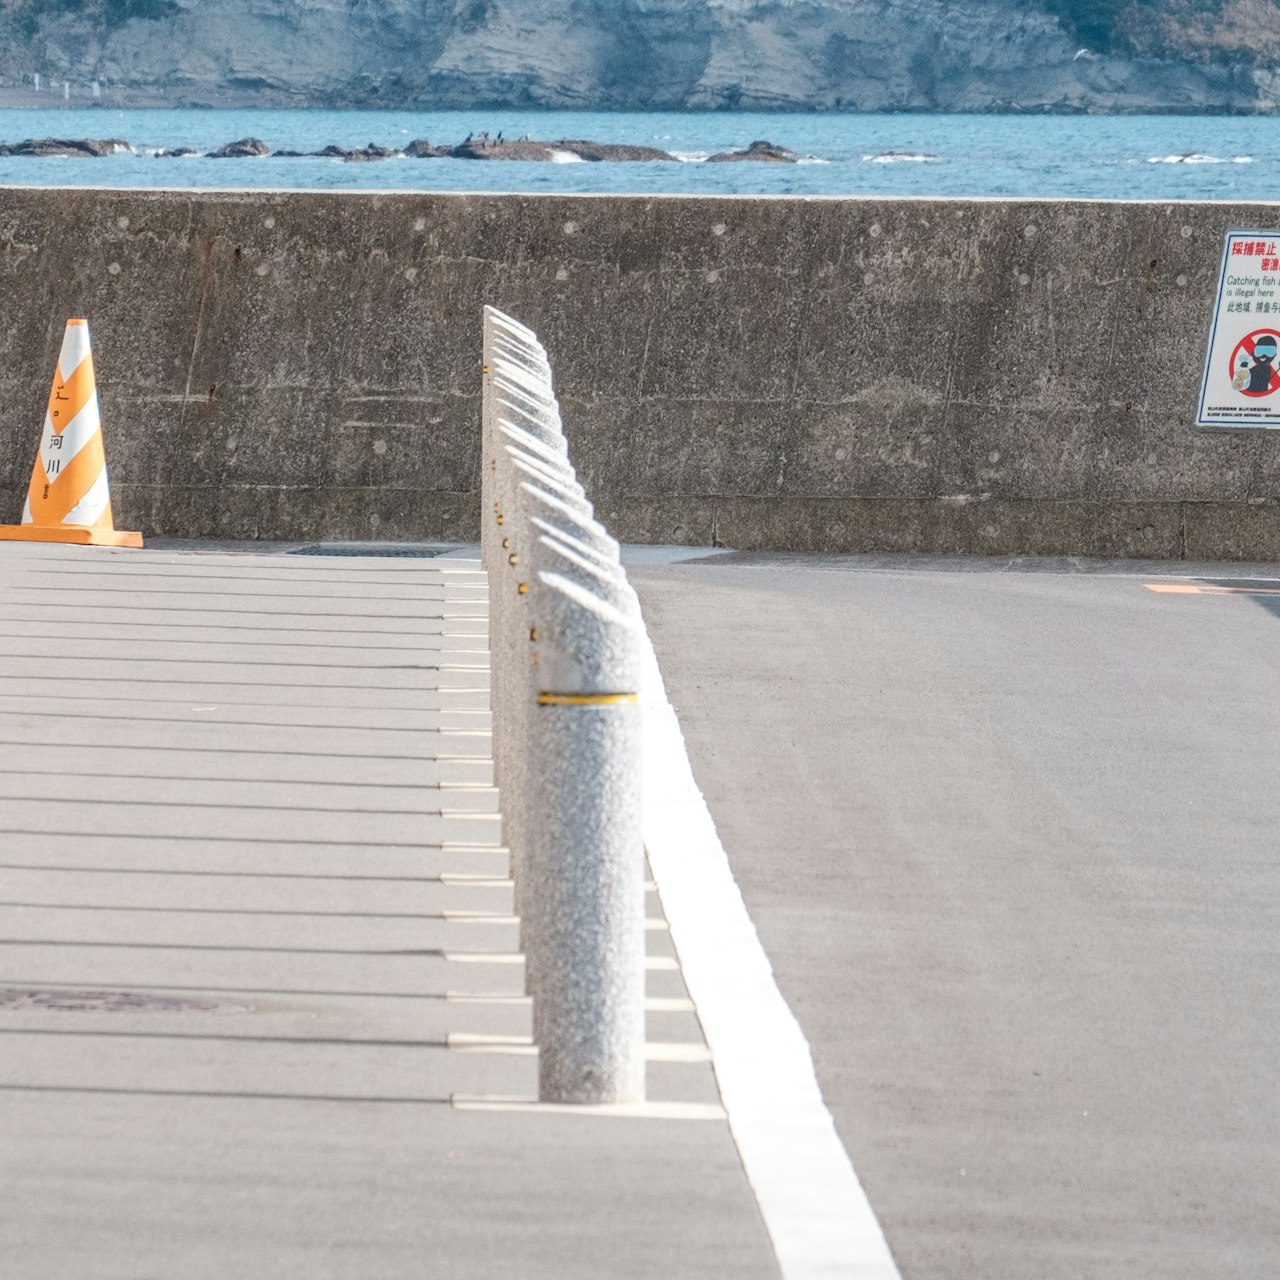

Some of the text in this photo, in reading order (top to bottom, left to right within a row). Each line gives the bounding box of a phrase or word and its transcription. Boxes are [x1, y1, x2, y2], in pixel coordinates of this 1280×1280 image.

[1231, 241, 1276, 255] 採捕禁止
[1227, 275, 1260, 287] Catching
[1263, 276, 1275, 286] fish
[1226, 288, 1274, 298] is illegal here
